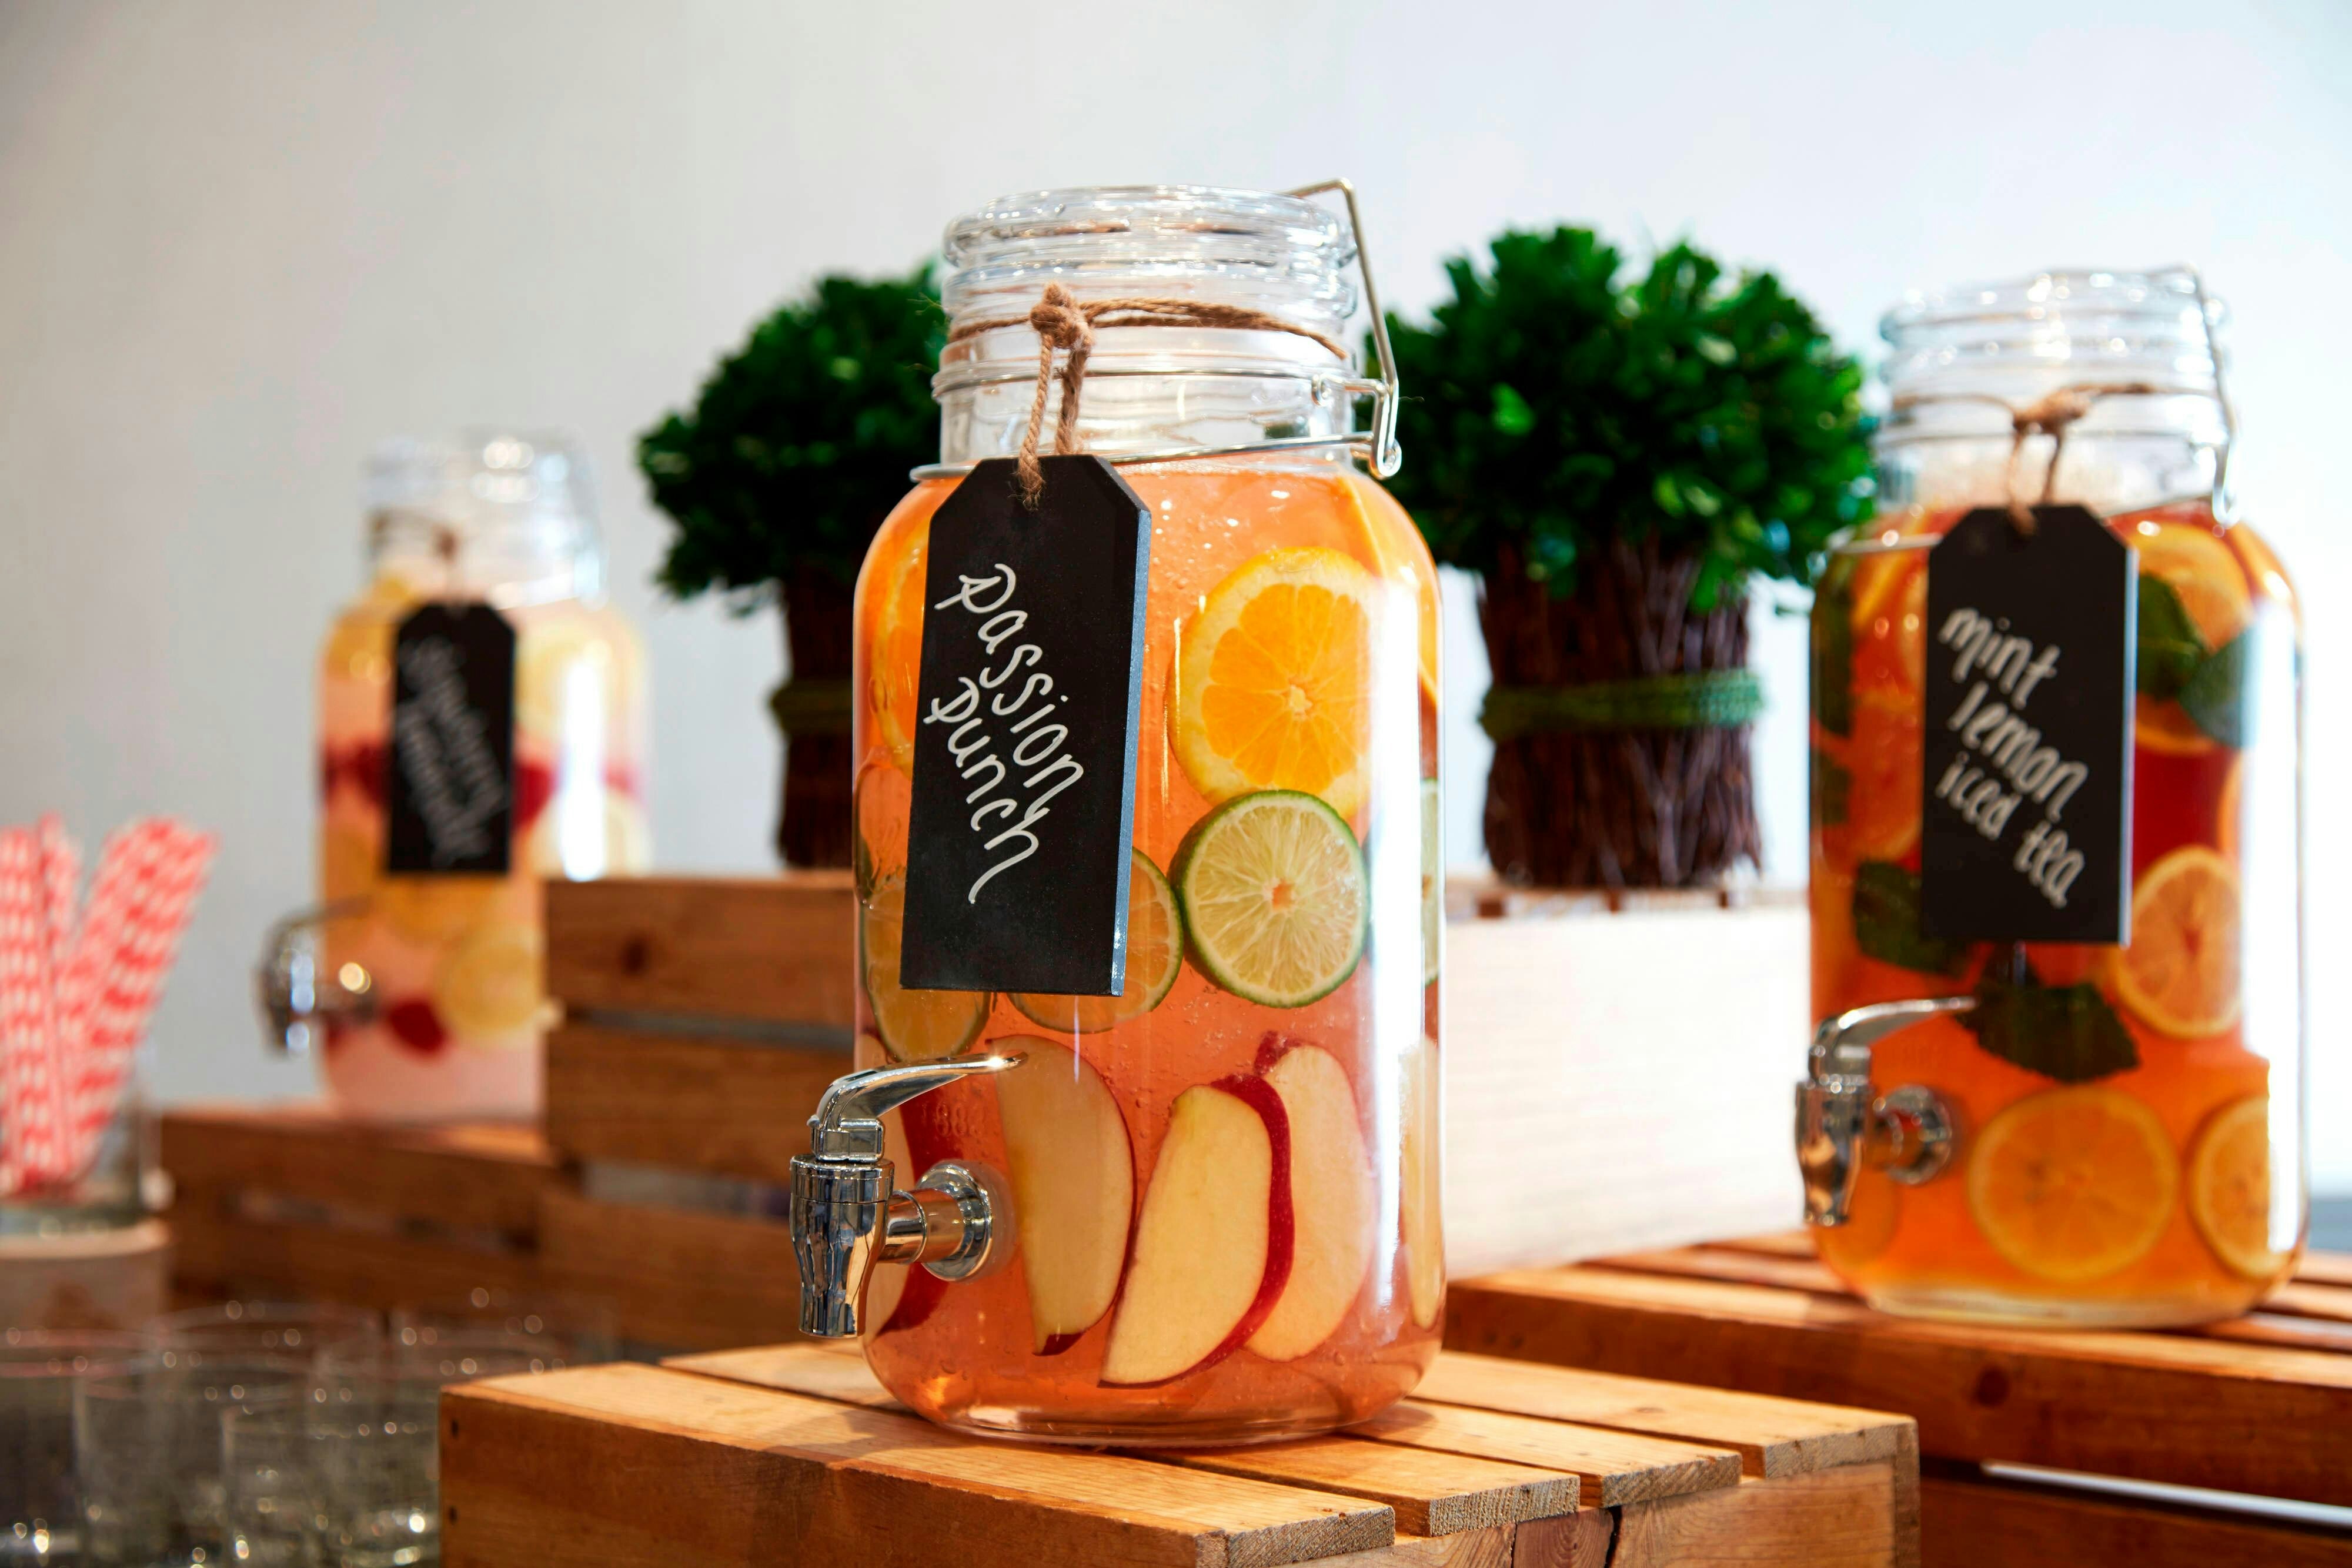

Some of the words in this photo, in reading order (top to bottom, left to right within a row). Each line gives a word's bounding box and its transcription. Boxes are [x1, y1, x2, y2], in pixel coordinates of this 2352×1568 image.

[1939, 608, 2060, 708] mint
[1948, 681, 2089, 821] lemon
[1936, 751, 2022, 840] iced
[2014, 821, 2086, 908] tea
